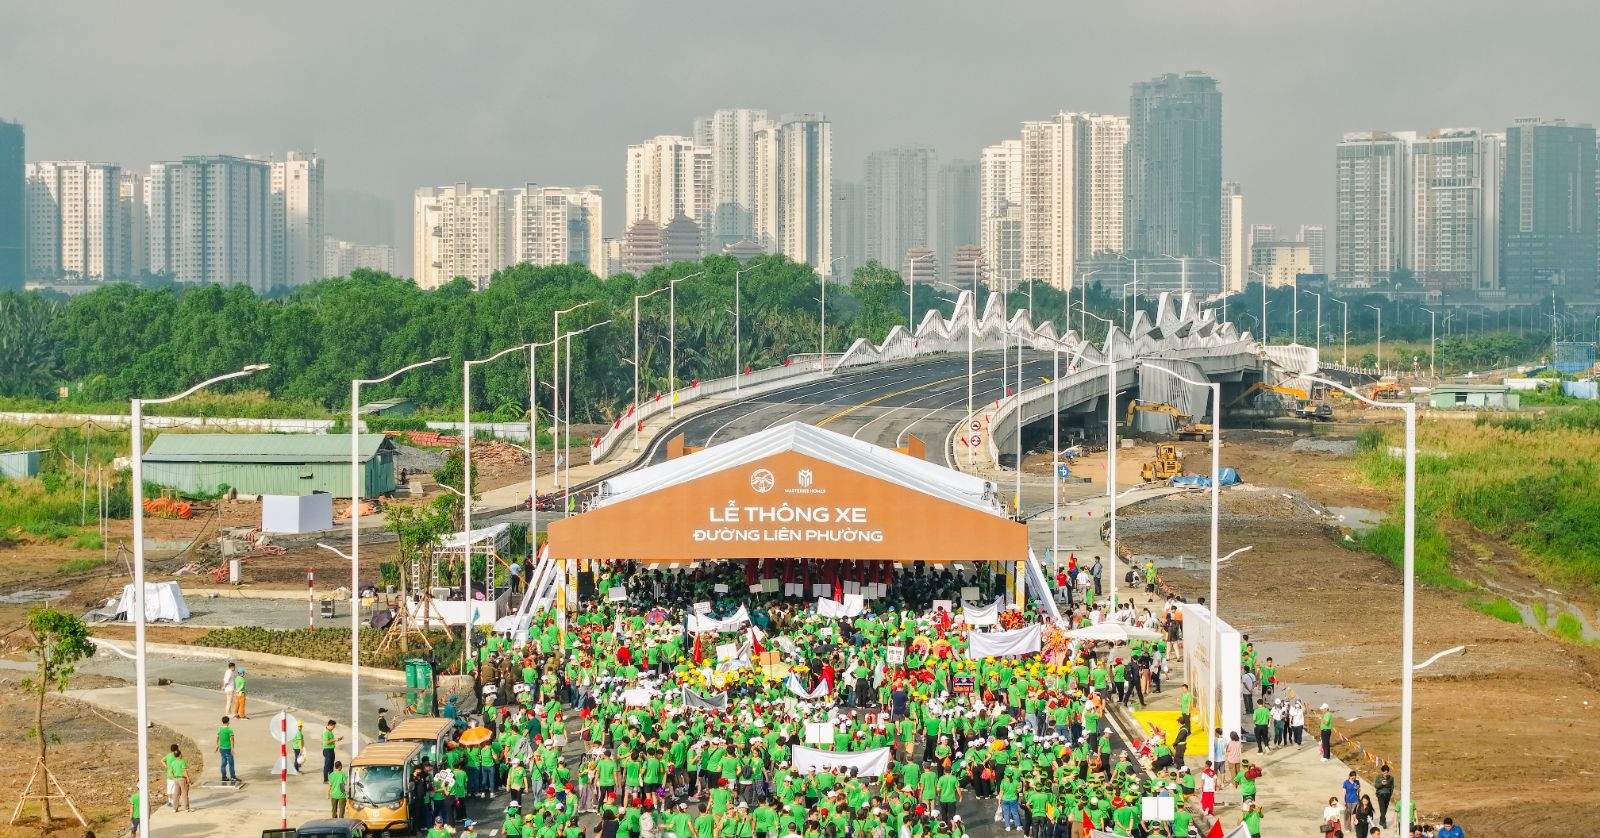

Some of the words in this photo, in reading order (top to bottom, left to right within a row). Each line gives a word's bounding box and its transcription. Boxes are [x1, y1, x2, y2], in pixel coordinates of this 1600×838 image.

[709, 500, 740, 522] LỄ
[743, 502, 830, 522] THÔNG
[834, 507, 867, 522] XE
[693, 527, 760, 541] ĐƯỜNG
[763, 527, 801, 541] LIÊN
[805, 527, 883, 542] PHƯỜNG
